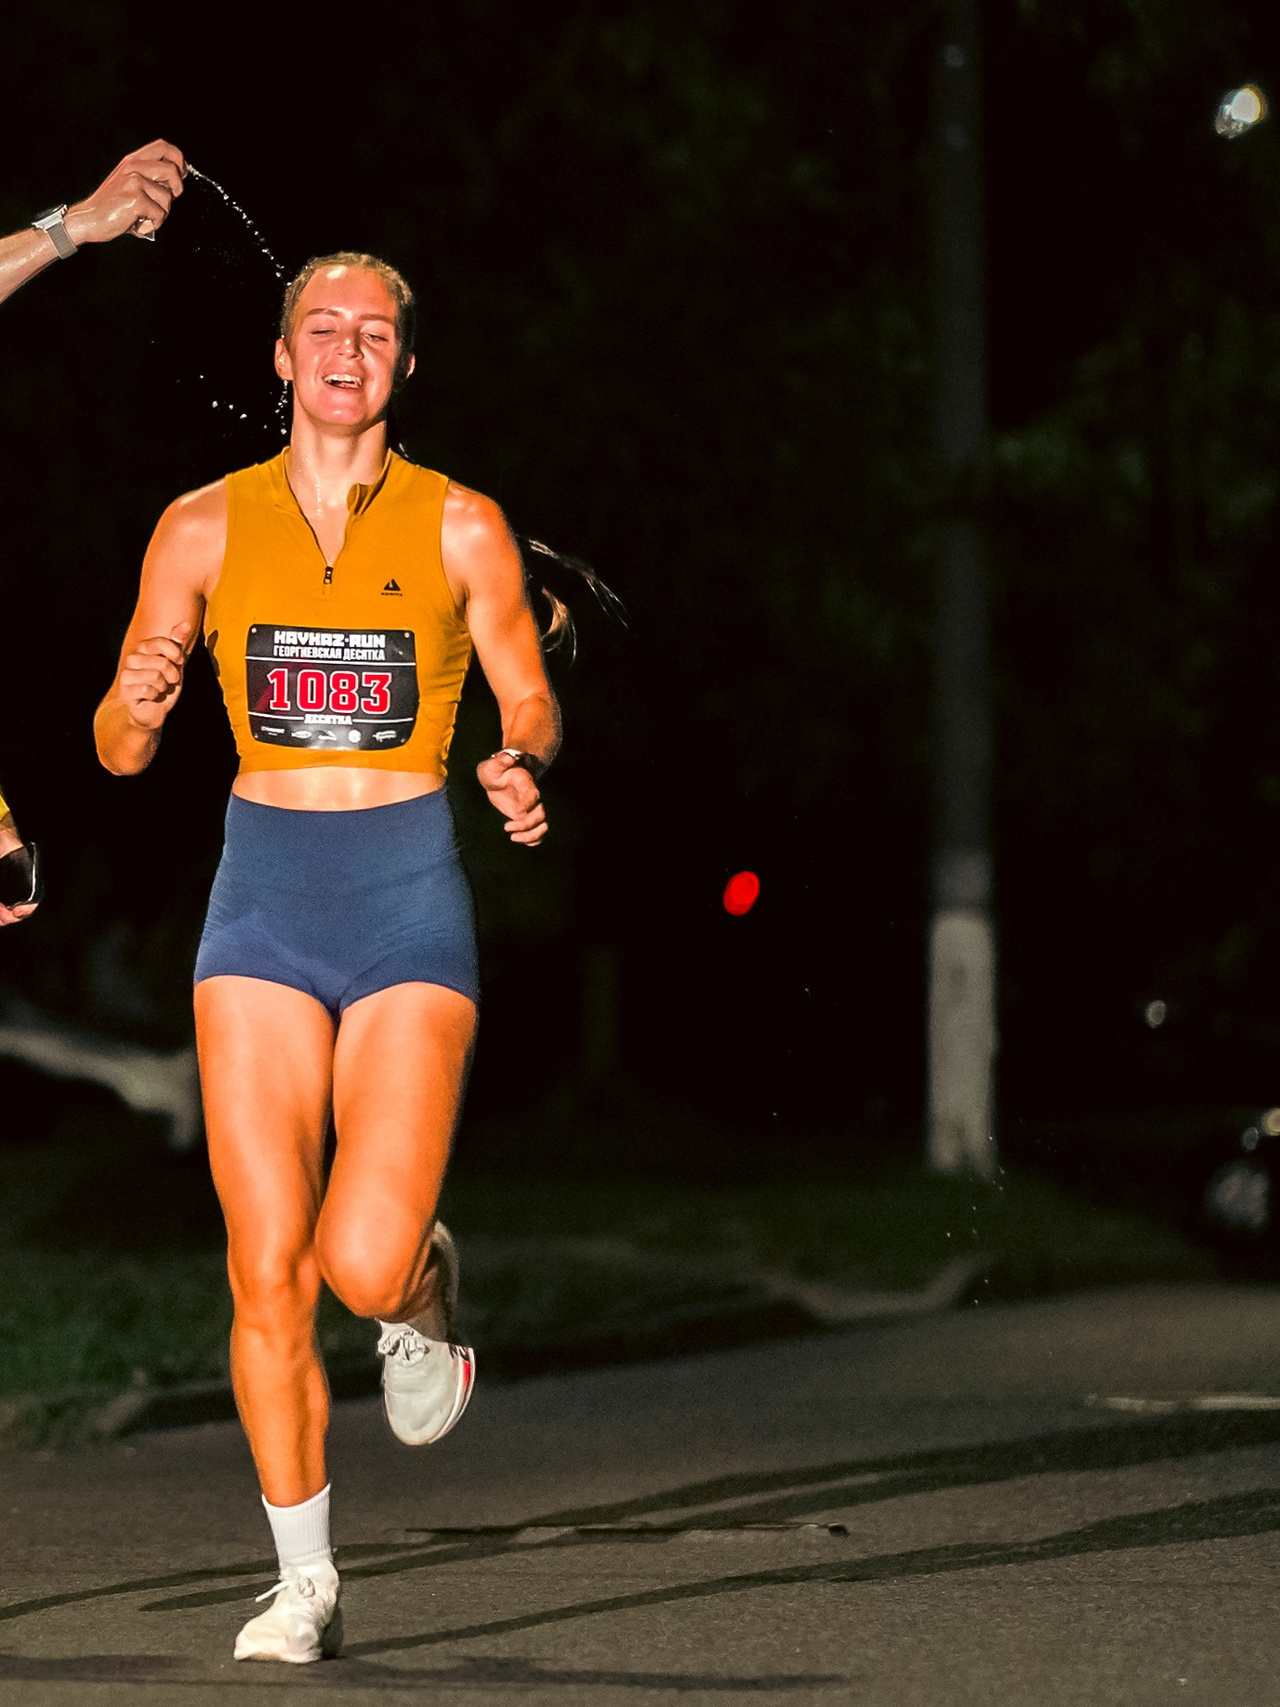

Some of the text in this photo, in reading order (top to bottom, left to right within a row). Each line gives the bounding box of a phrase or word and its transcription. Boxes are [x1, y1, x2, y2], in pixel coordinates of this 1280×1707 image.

[273, 645, 386, 661] ГЕОРГИЕВСКАЯ ДЕСЯТКА
[267, 668, 392, 715] 1083
